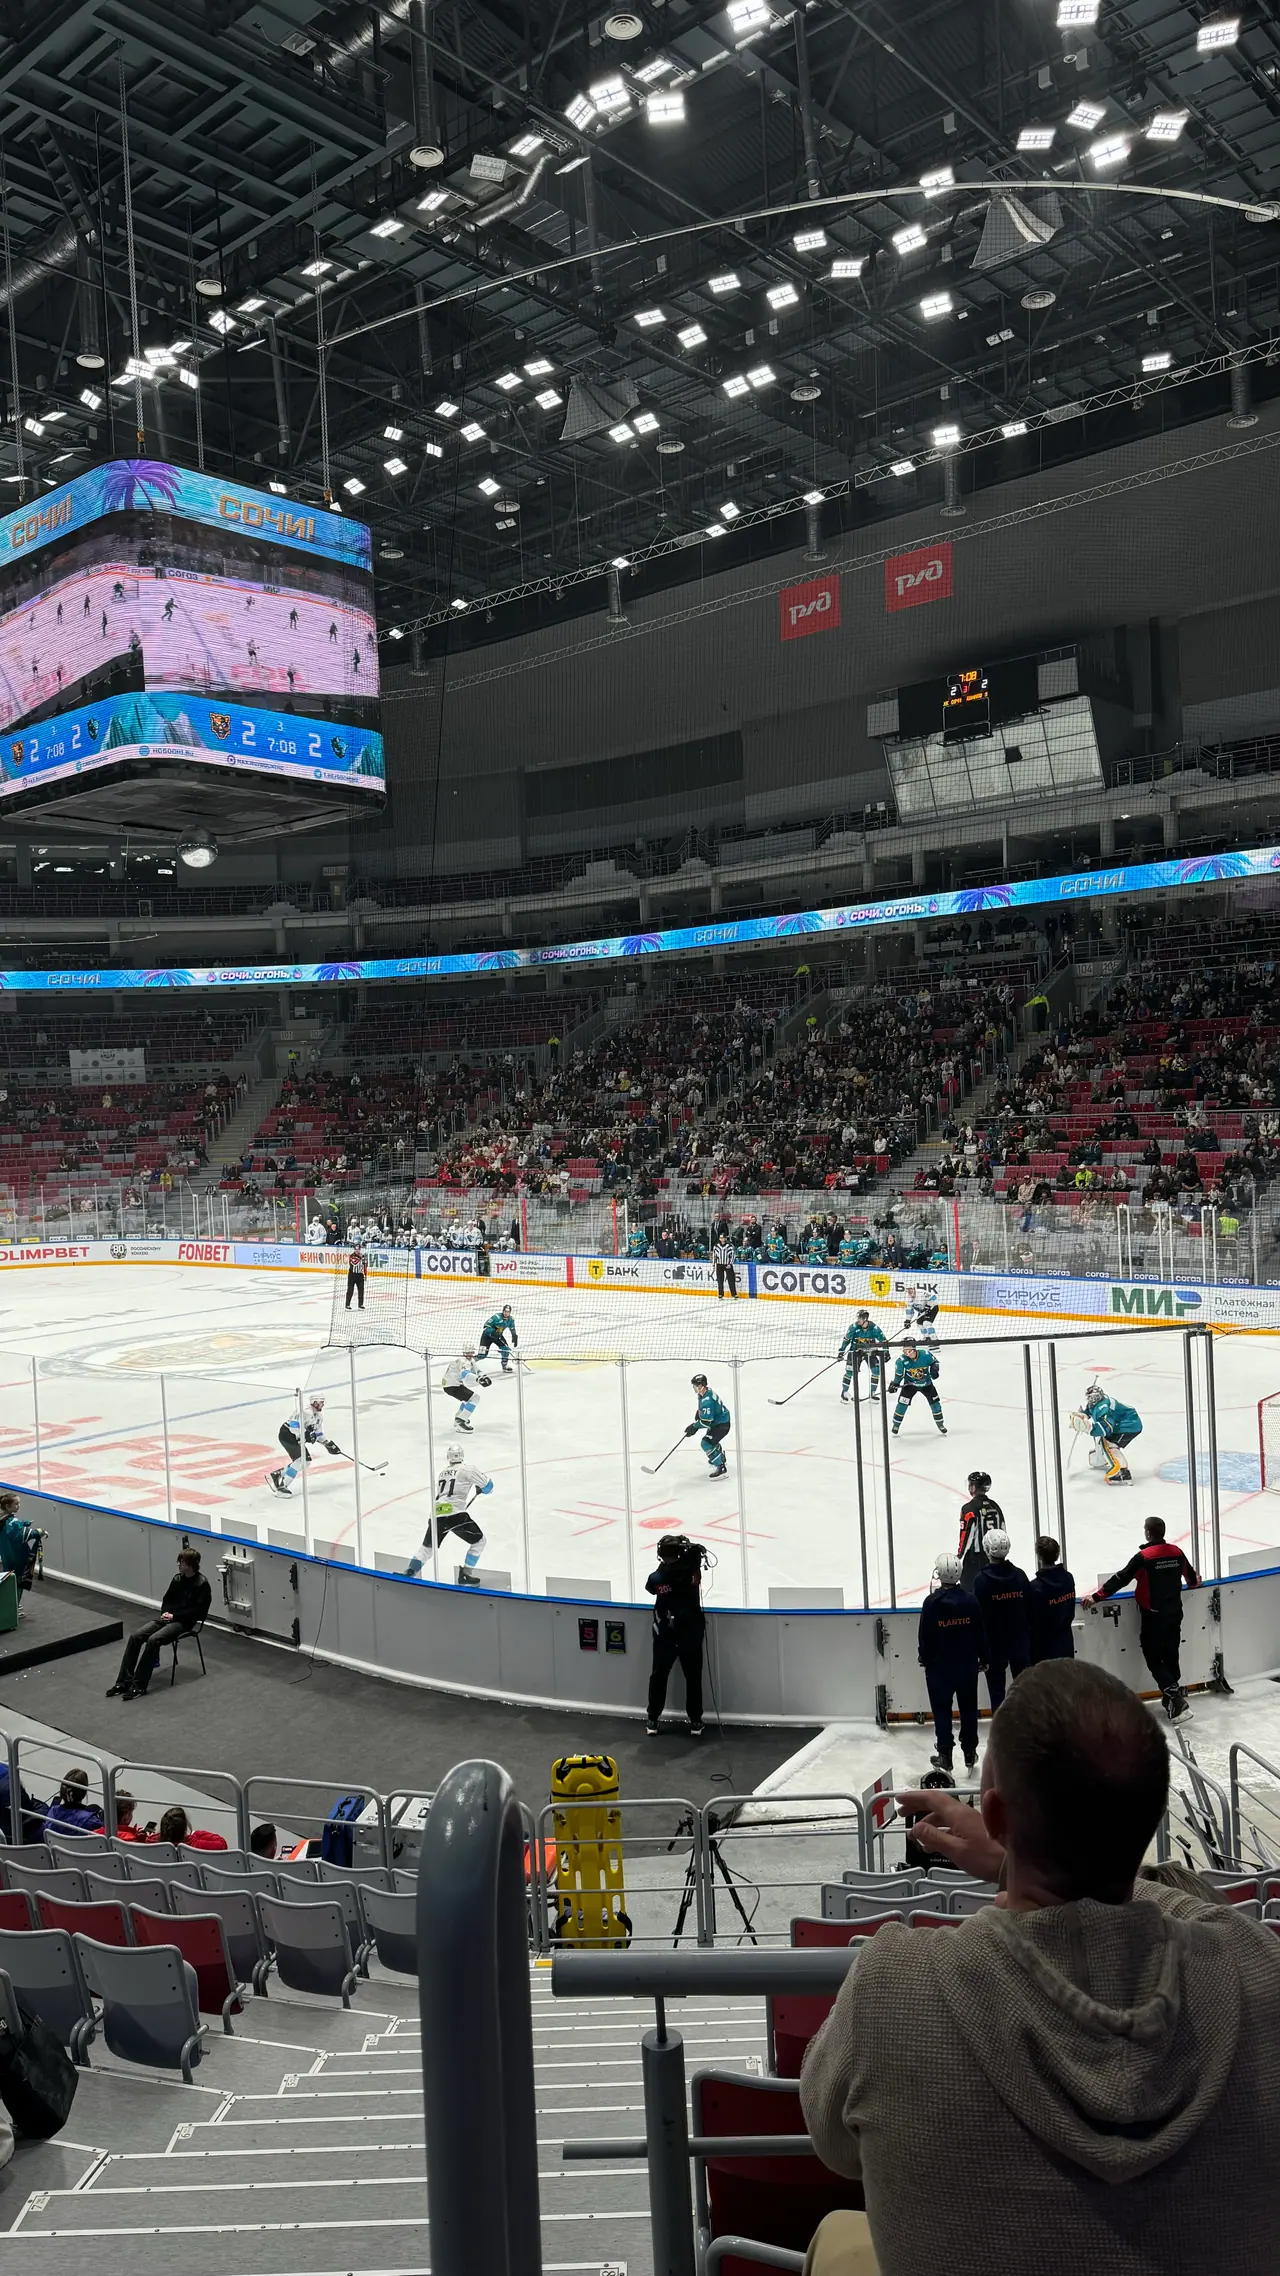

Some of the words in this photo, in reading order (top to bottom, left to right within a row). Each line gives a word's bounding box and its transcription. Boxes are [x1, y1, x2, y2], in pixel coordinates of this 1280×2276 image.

[11, 494, 72, 548] СОЧИ!
[218, 495, 316, 541] СОЧИ!
[959, 670, 977, 682] 7:08
[963, 685, 968, 693] 3
[981, 679, 988, 688] 2
[950, 686, 957, 696] 2
[242, 720, 256, 746] 2
[277, 722, 284, 732] 3
[72, 724, 82, 750] 2
[29, 739, 39, 763] 2
[46, 742, 65, 760] 7:08
[268, 738, 297, 755] 7:08
[308, 733, 322, 758] 2
[1060, 871, 1125, 894] СОЧИ!
[693, 926, 738, 943] СОЧИ!
[397, 958, 441, 972] СОЧИ!
[48, 974, 101, 985] СОЧИ!
[112, 1244, 123, 1253] 80
[178, 1244, 230, 1261] FONBET
[300, 1251, 351, 1265] КИНОПОИС
[366, 1253, 389, 1268] ИР
[606, 1266, 639, 1277] БАНК
[895, 1281, 938, 1294] БНК
[997, 1288, 1061, 1302] СИРИУС
[1111, 1287, 1202, 1317] МИР
[1215, 1297, 1275, 1309] Платёжная
[1215, 1310, 1259, 1318] система
[702, 1407, 711, 1415] 76
[437, 1479, 456, 1498] 71
[991, 1590, 1024, 1601] PLANTIC
[938, 1617, 971, 1627] PLANTIC
[583, 1627, 594, 1639] 5
[610, 1630, 621, 1642] 6
